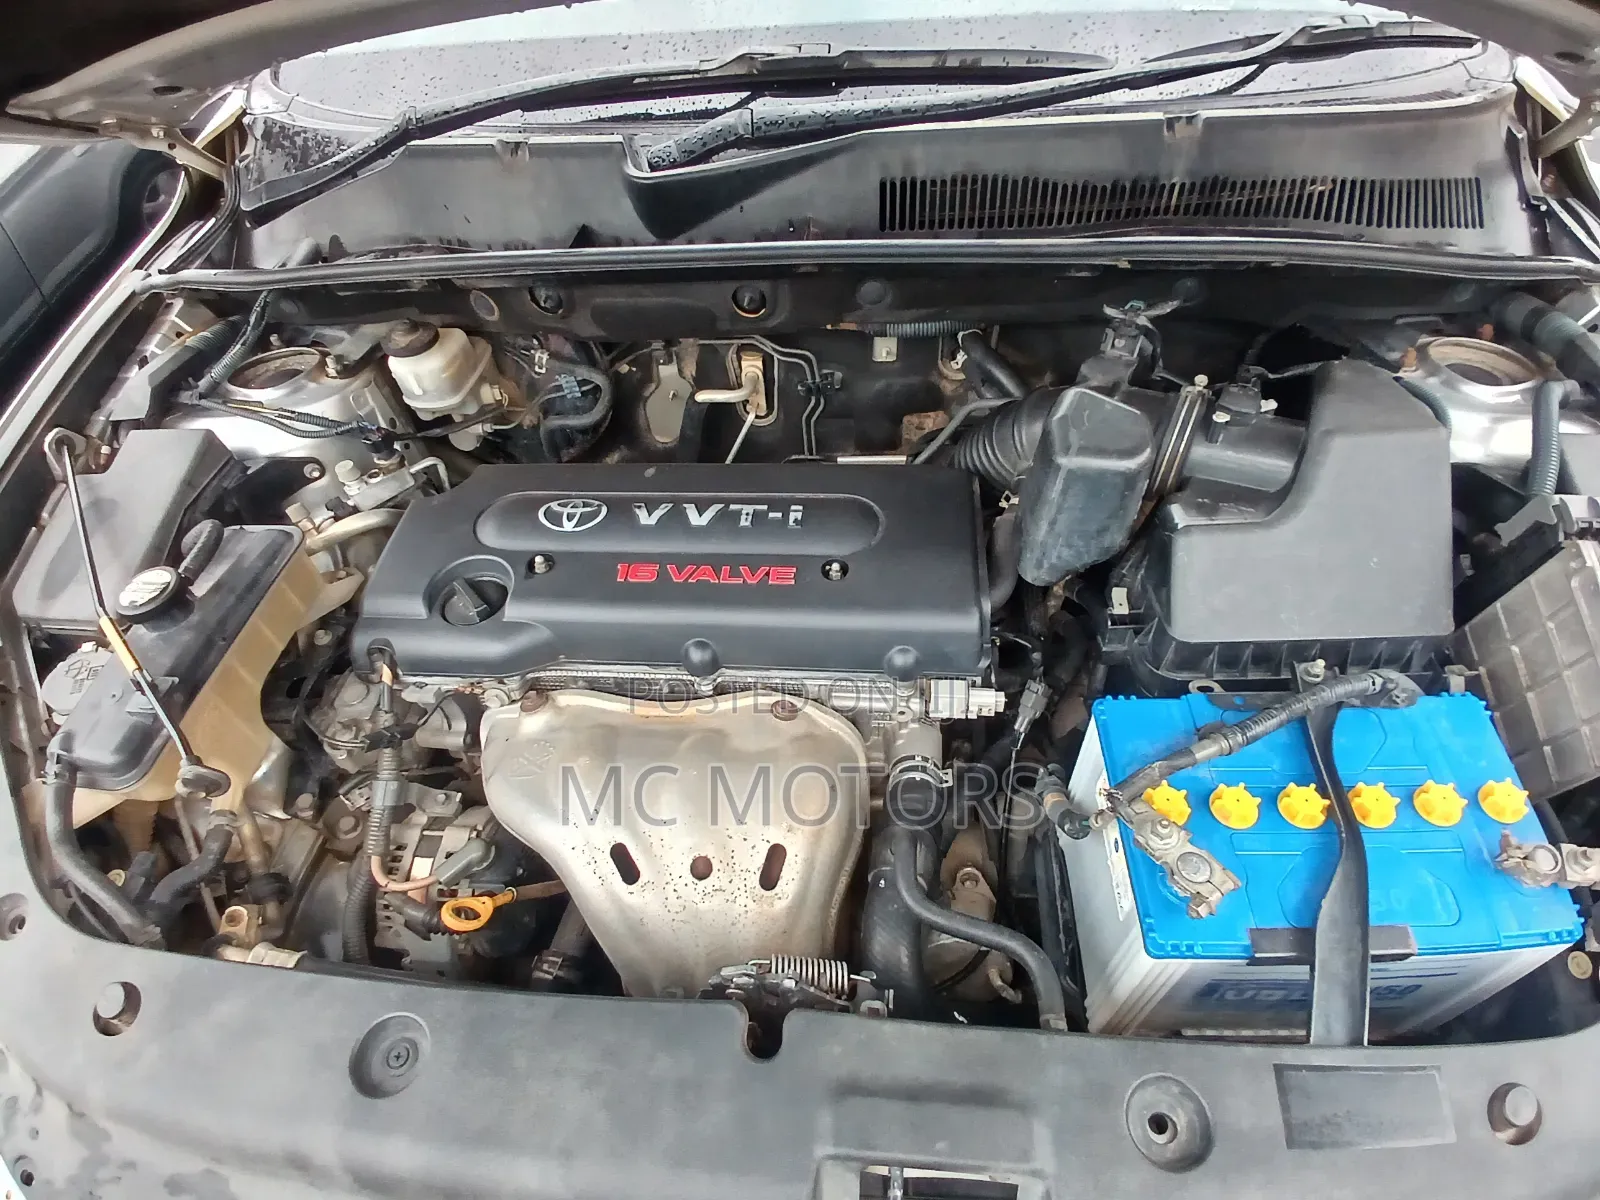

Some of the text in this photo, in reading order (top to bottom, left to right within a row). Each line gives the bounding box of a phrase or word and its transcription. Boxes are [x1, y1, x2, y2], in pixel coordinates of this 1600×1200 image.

[632, 502, 804, 529] VVT-i
[616, 563, 797, 585] 16 VALVE
